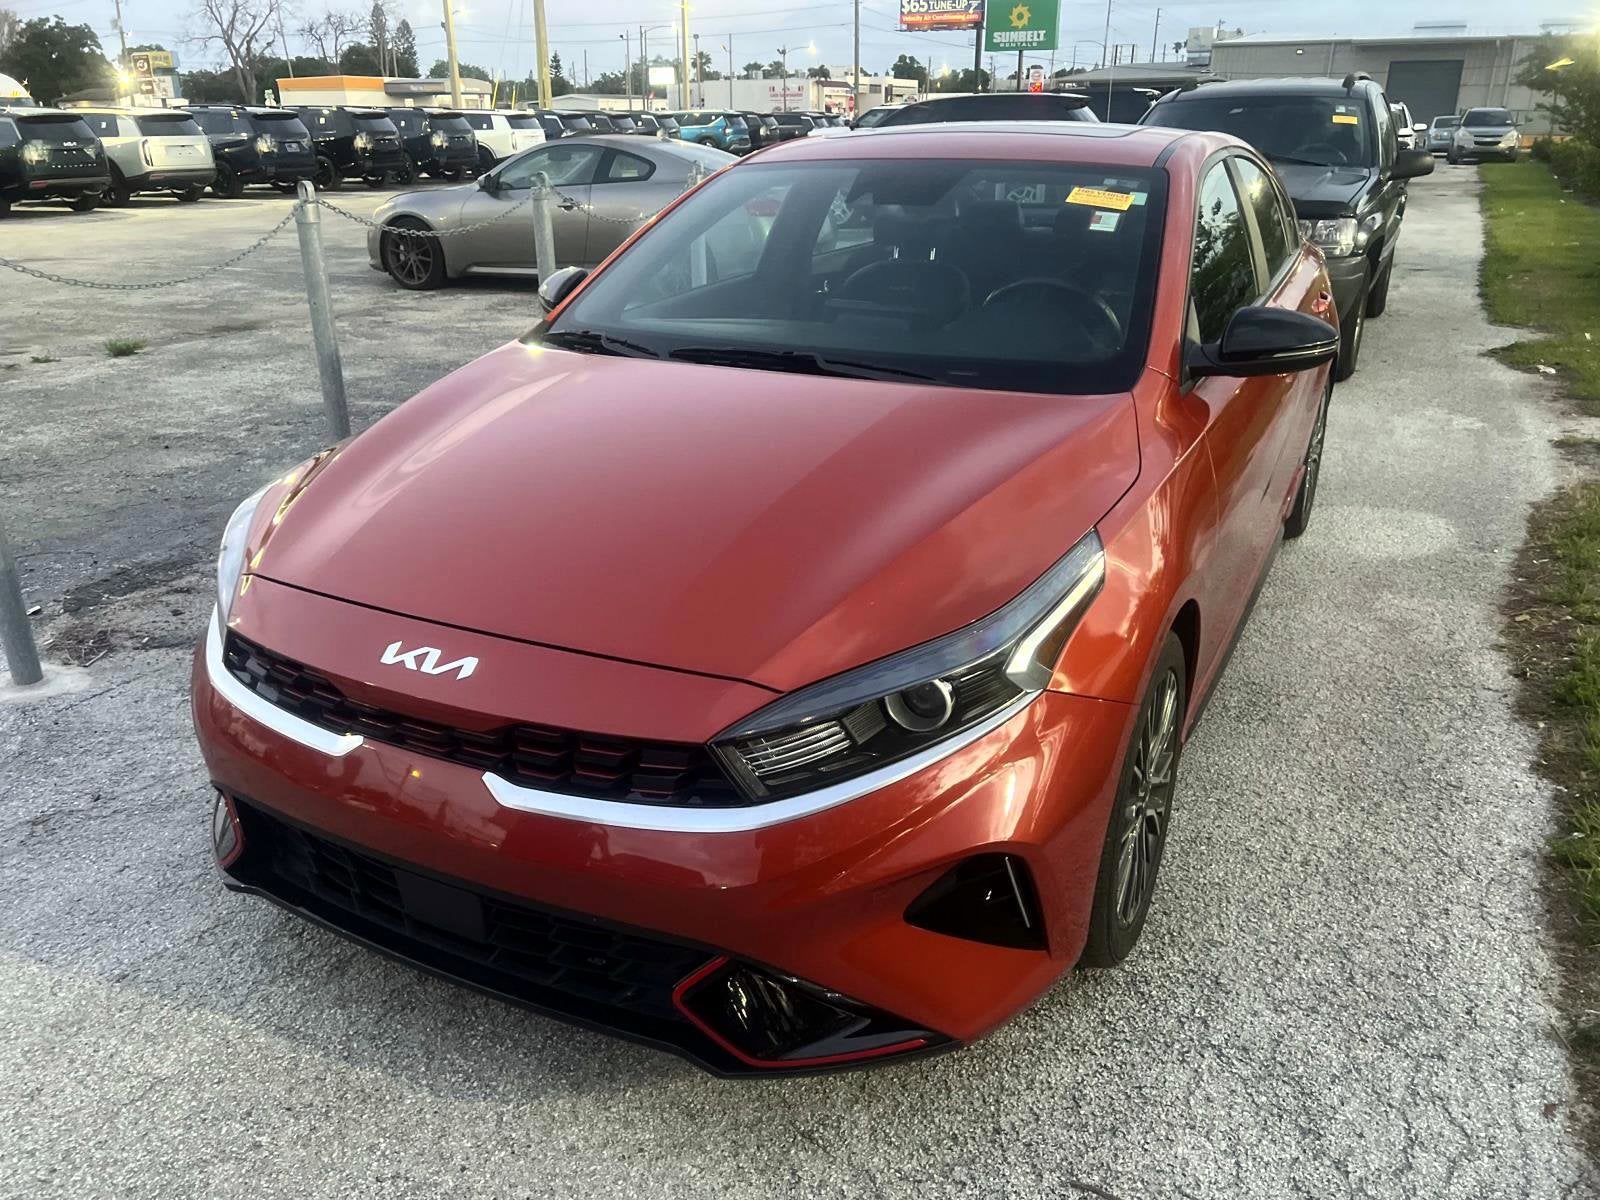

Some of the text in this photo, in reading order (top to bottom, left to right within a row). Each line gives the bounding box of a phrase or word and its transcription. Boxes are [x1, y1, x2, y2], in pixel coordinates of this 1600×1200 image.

[928, 0, 968, 10] TUNE-UP
[993, 30, 1046, 43] SUNBELT
[380, 641, 479, 680] KIA
